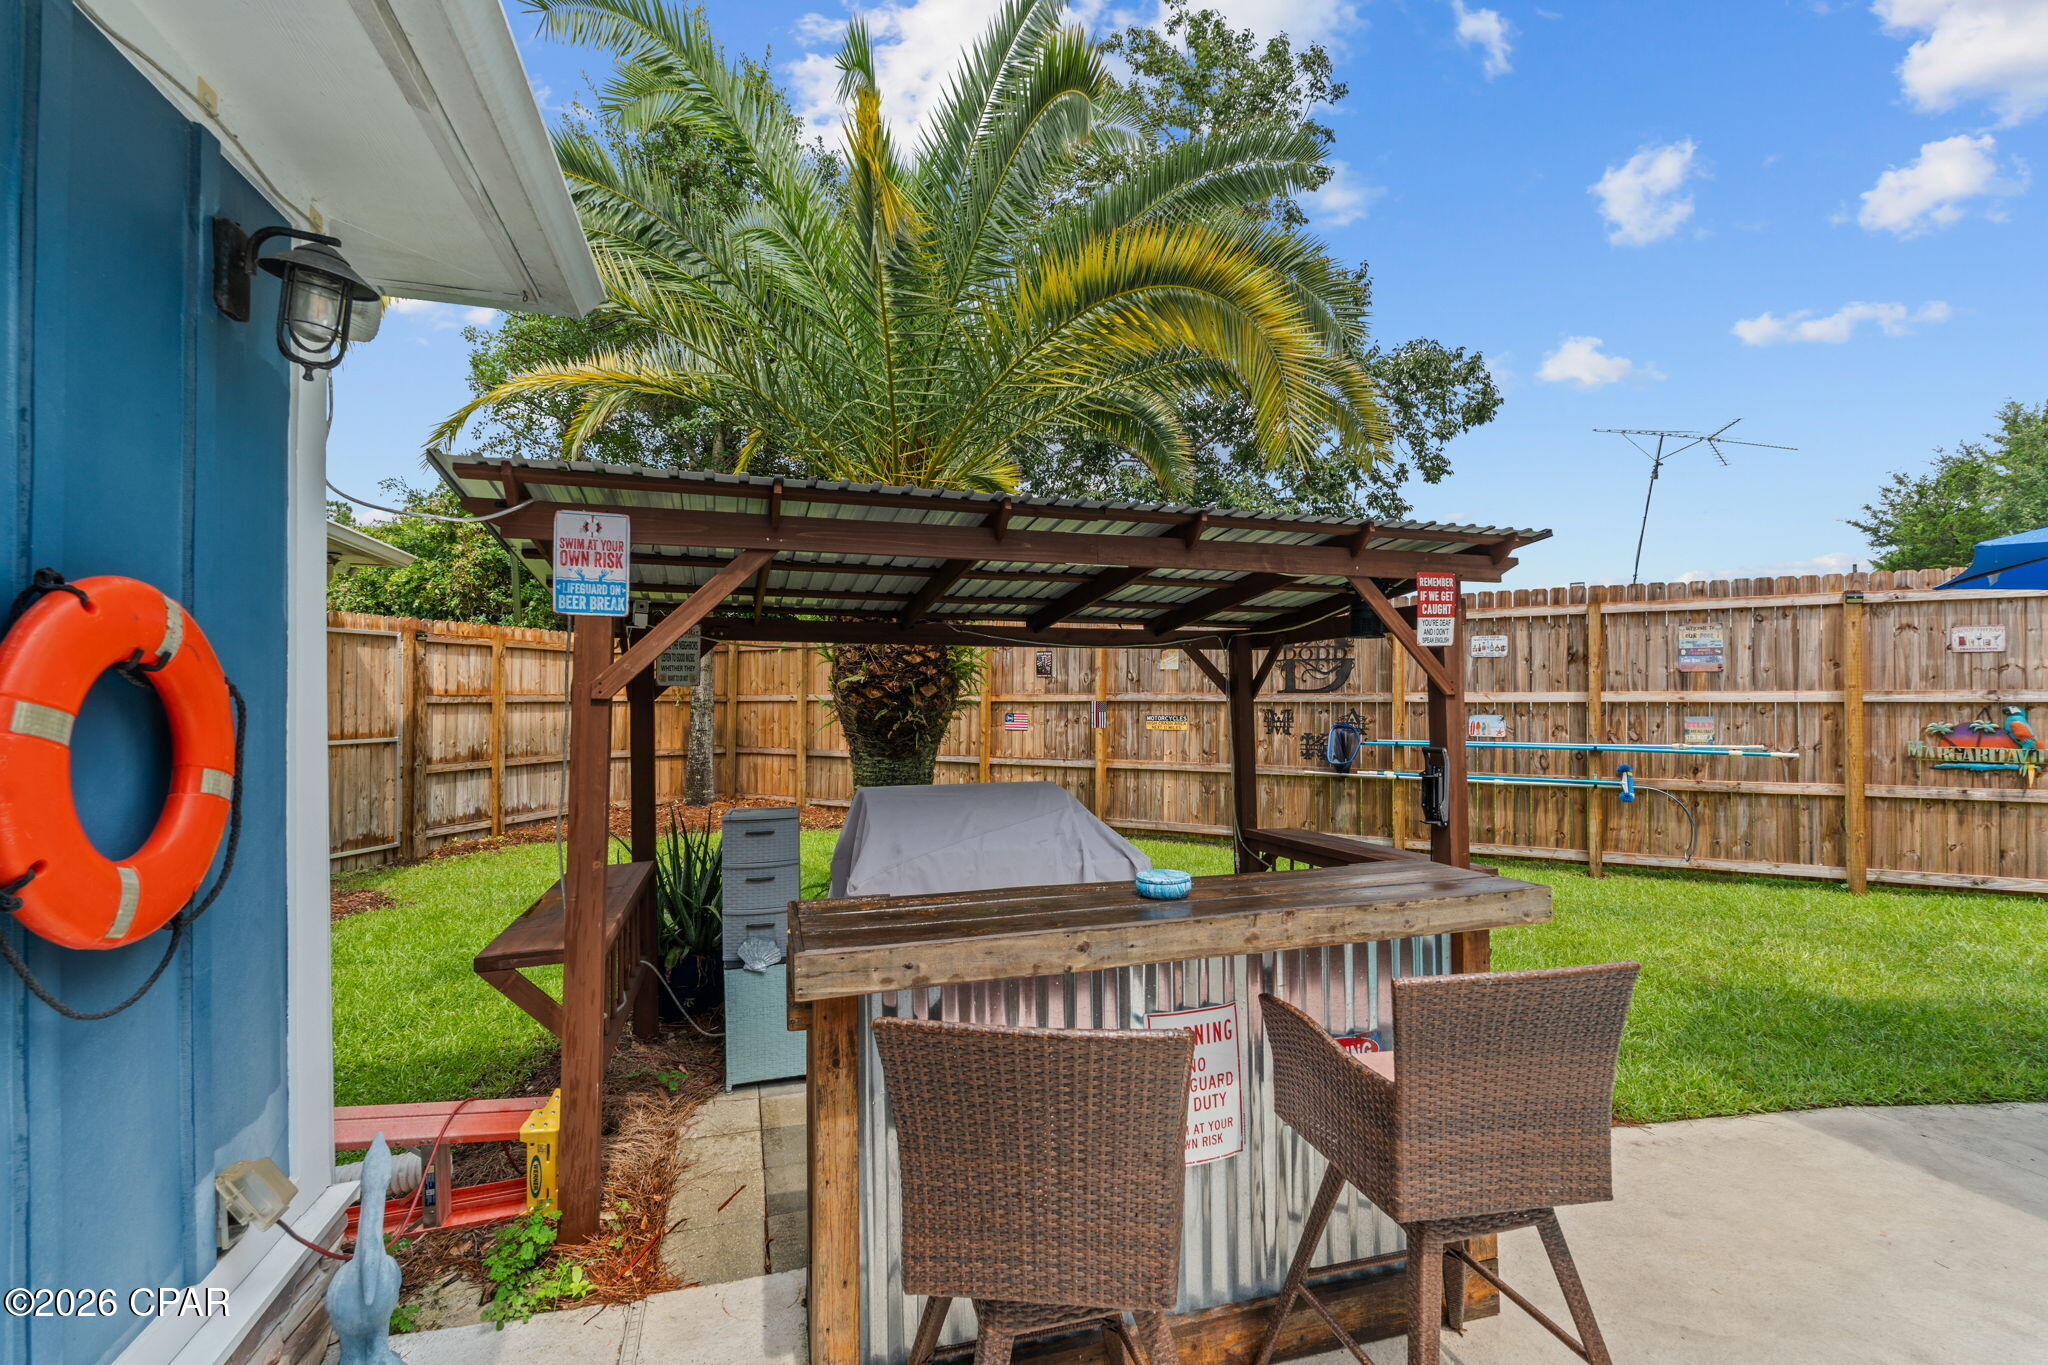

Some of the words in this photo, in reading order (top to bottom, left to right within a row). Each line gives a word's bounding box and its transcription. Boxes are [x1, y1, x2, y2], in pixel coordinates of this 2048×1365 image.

[560, 537, 584, 550] SWIM
[588, 539, 598, 550] AT
[601, 539, 624, 552] YOUR
[560, 550, 590, 567] OWN
[594, 552, 624, 569] RISK
[562, 583, 608, 595] LIFEGUARD
[610, 585, 621, 595] ON
[1419, 577, 1454, 587] REMEMBER
[558, 595, 587, 610] BEER
[590, 596, 625, 611] BREAK
[1420, 591, 1428, 601] IF
[1428, 591, 1440, 601] WE
[1441, 591, 1454, 601] GET
[1421, 604, 1452, 615] CAUGHT
[1422, 619, 1439, 627] YOU'RE
[1439, 619, 1452, 627] DEAF
[1423, 628, 1434, 636] AND
[1184, 1018, 1232, 1045] NING
[1194, 1092, 1227, 1112] DUTY
[1194, 1122, 1205, 1135] AT
[1208, 1117, 1233, 1132] YOUR
[1202, 1133, 1223, 1147] RISK
